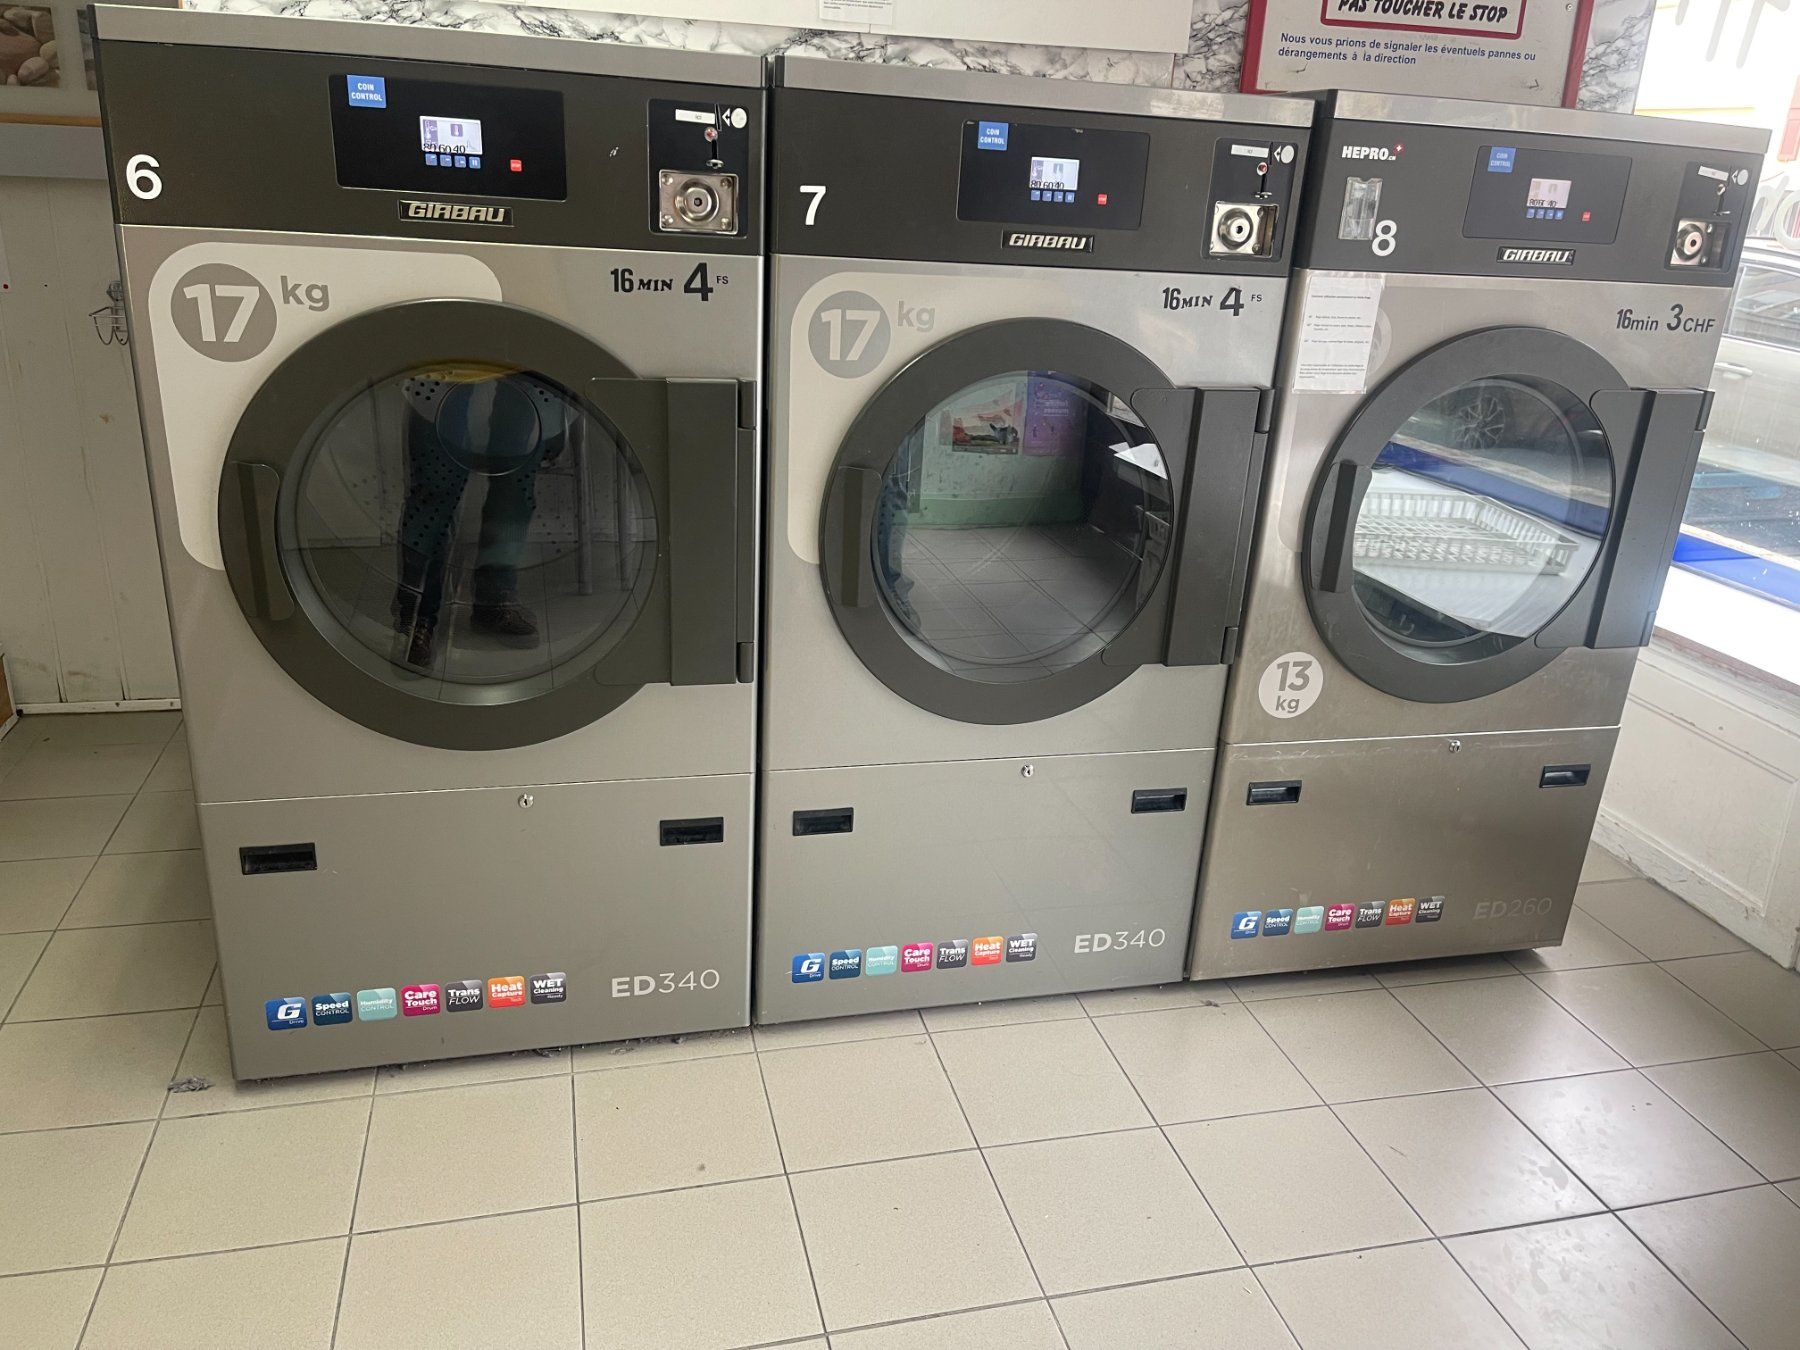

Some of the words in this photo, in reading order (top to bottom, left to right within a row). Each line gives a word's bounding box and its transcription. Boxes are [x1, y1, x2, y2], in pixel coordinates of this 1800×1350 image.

[1373, 0, 1445, 19] TOUCHER
[1448, 2, 1468, 20] LE
[1469, 4, 1508, 23] STOP
[1280, 32, 1306, 44] Nous
[1309, 36, 1333, 46] vous
[1336, 37, 1366, 48] prions
[1369, 39, 1381, 49] de
[1383, 40, 1422, 52] signaler
[1424, 43, 1438, 53] les
[1441, 44, 1486, 57] éventuels
[1488, 49, 1521, 59] pannes
[1524, 52, 1536, 61] ou
[1278, 46, 1347, 60] dérangements
[1363, 52, 1371, 61] la
[1374, 53, 1416, 64] direction
[357, 82, 375, 92] COIN
[351, 92, 383, 101] CONTROL
[986, 128, 1000, 136] COIN
[980, 137, 1005, 145] CONTROL
[126, 154, 163, 200] 6
[799, 185, 827, 226] 7
[408, 203, 505, 222] GIRBAU
[1009, 233, 1087, 250] GIRBAU
[1371, 219, 1397, 257] 8
[1502, 249, 1570, 263] GIRBAU
[183, 283, 260, 343] 17
[280, 275, 330, 312] kg
[820, 308, 881, 361] 17
[897, 300, 936, 333] kg
[1276, 660, 1313, 692] 13
[1275, 695, 1300, 713] kg
[1389, 903, 1413, 911] Heat
[1420, 900, 1442, 910] WET
[1473, 897, 1552, 920] ED260
[1328, 908, 1352, 917] Care
[1238, 916, 1258, 930] G
[1266, 916, 1290, 924] Speed
[1328, 915, 1351, 923] Touch
[1357, 914, 1380, 922] FLOW
[1009, 938, 1035, 948] WET
[1073, 928, 1166, 953] ED340
[939, 947, 966, 955] Trans
[974, 942, 1001, 951] Heat
[904, 948, 930, 957] Care
[831, 956, 860, 966] Speed
[904, 956, 930, 964] Touch
[939, 954, 964, 963] FLOW
[800, 958, 822, 973] G
[831, 963, 859, 971] CONTROL
[491, 982, 523, 992] Heat
[533, 978, 564, 988] WET
[611, 969, 720, 998] ED340
[404, 990, 437, 999] Care
[448, 988, 481, 997] Trans
[491, 990, 523, 998] Capture
[533, 986, 564, 995] Cleaning
[315, 1000, 349, 1011] Speed
[405, 998, 438, 1007] Touch
[449, 996, 481, 1005] FLOW
[277, 1003, 302, 1020] G
[315, 1009, 350, 1017] CONTROL
